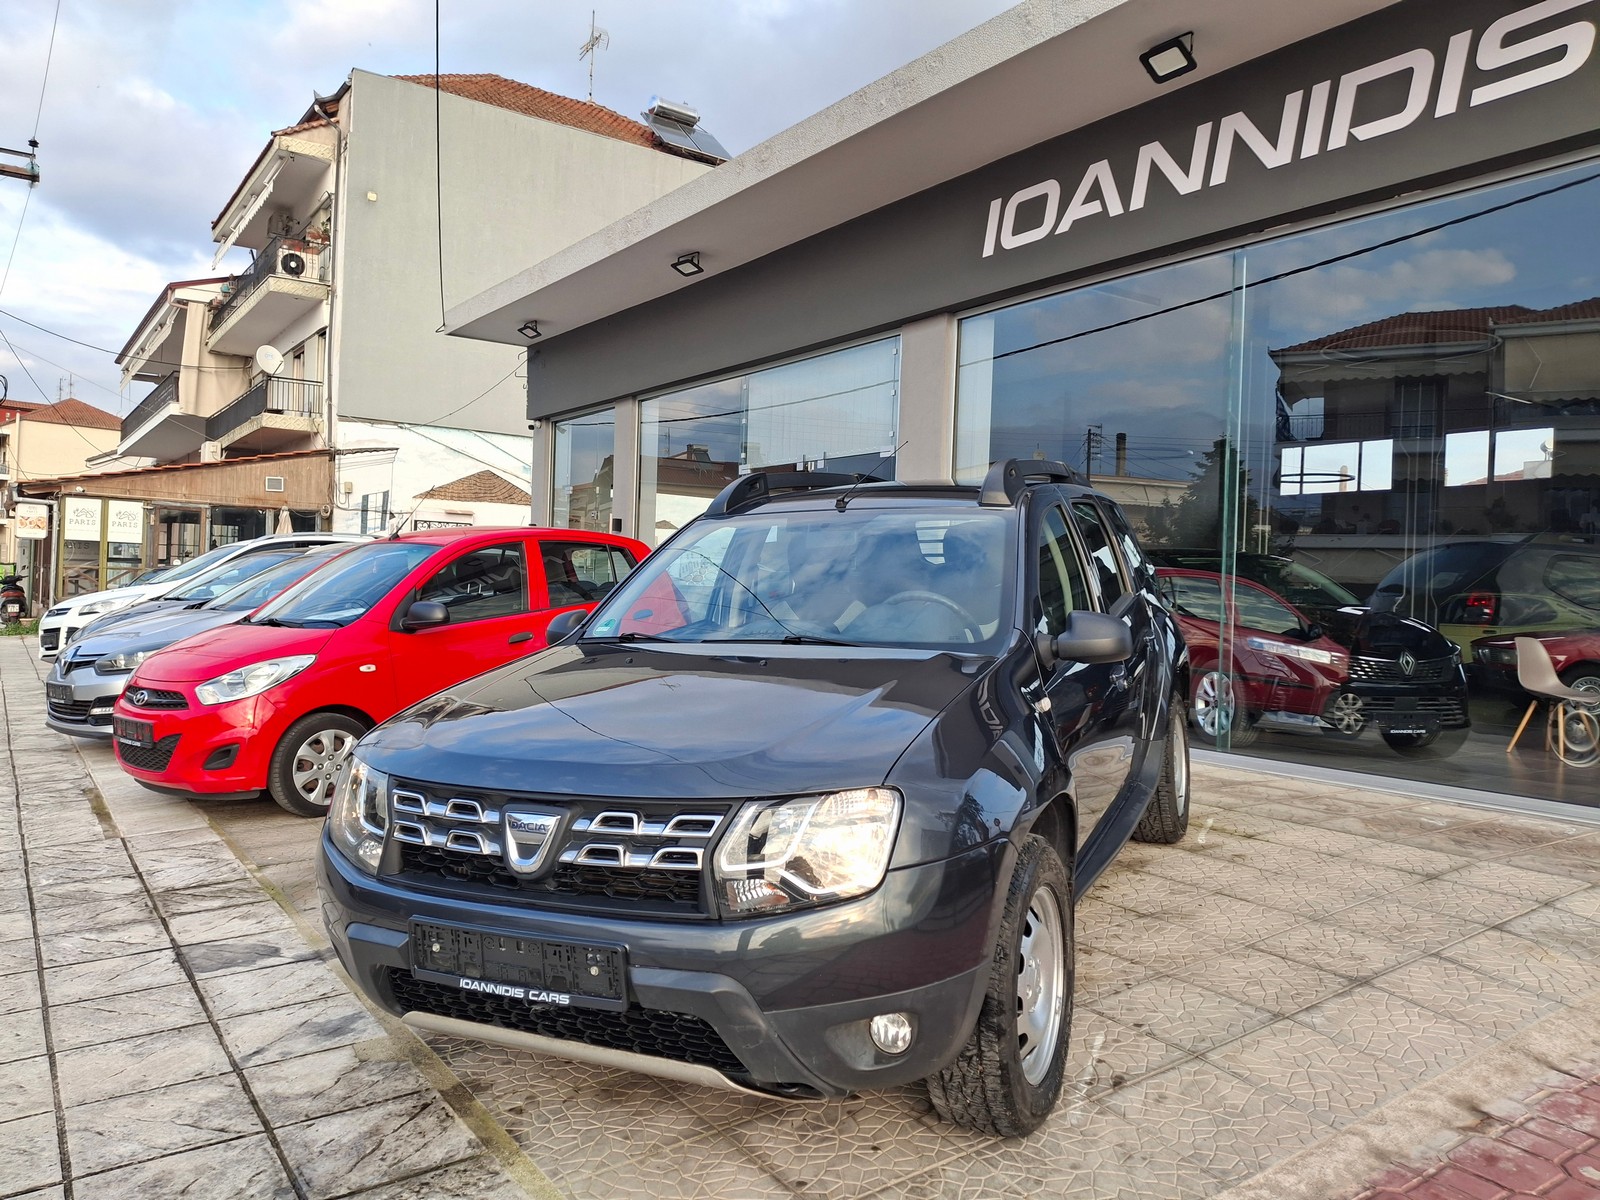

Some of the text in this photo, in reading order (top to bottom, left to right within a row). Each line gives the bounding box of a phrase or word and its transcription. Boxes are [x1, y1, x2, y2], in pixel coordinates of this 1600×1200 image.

[982, 0, 1596, 259] IOANNIDIS
[511, 821, 546, 831] DACIA
[460, 979, 570, 1004] IOANNIDIS CARS
